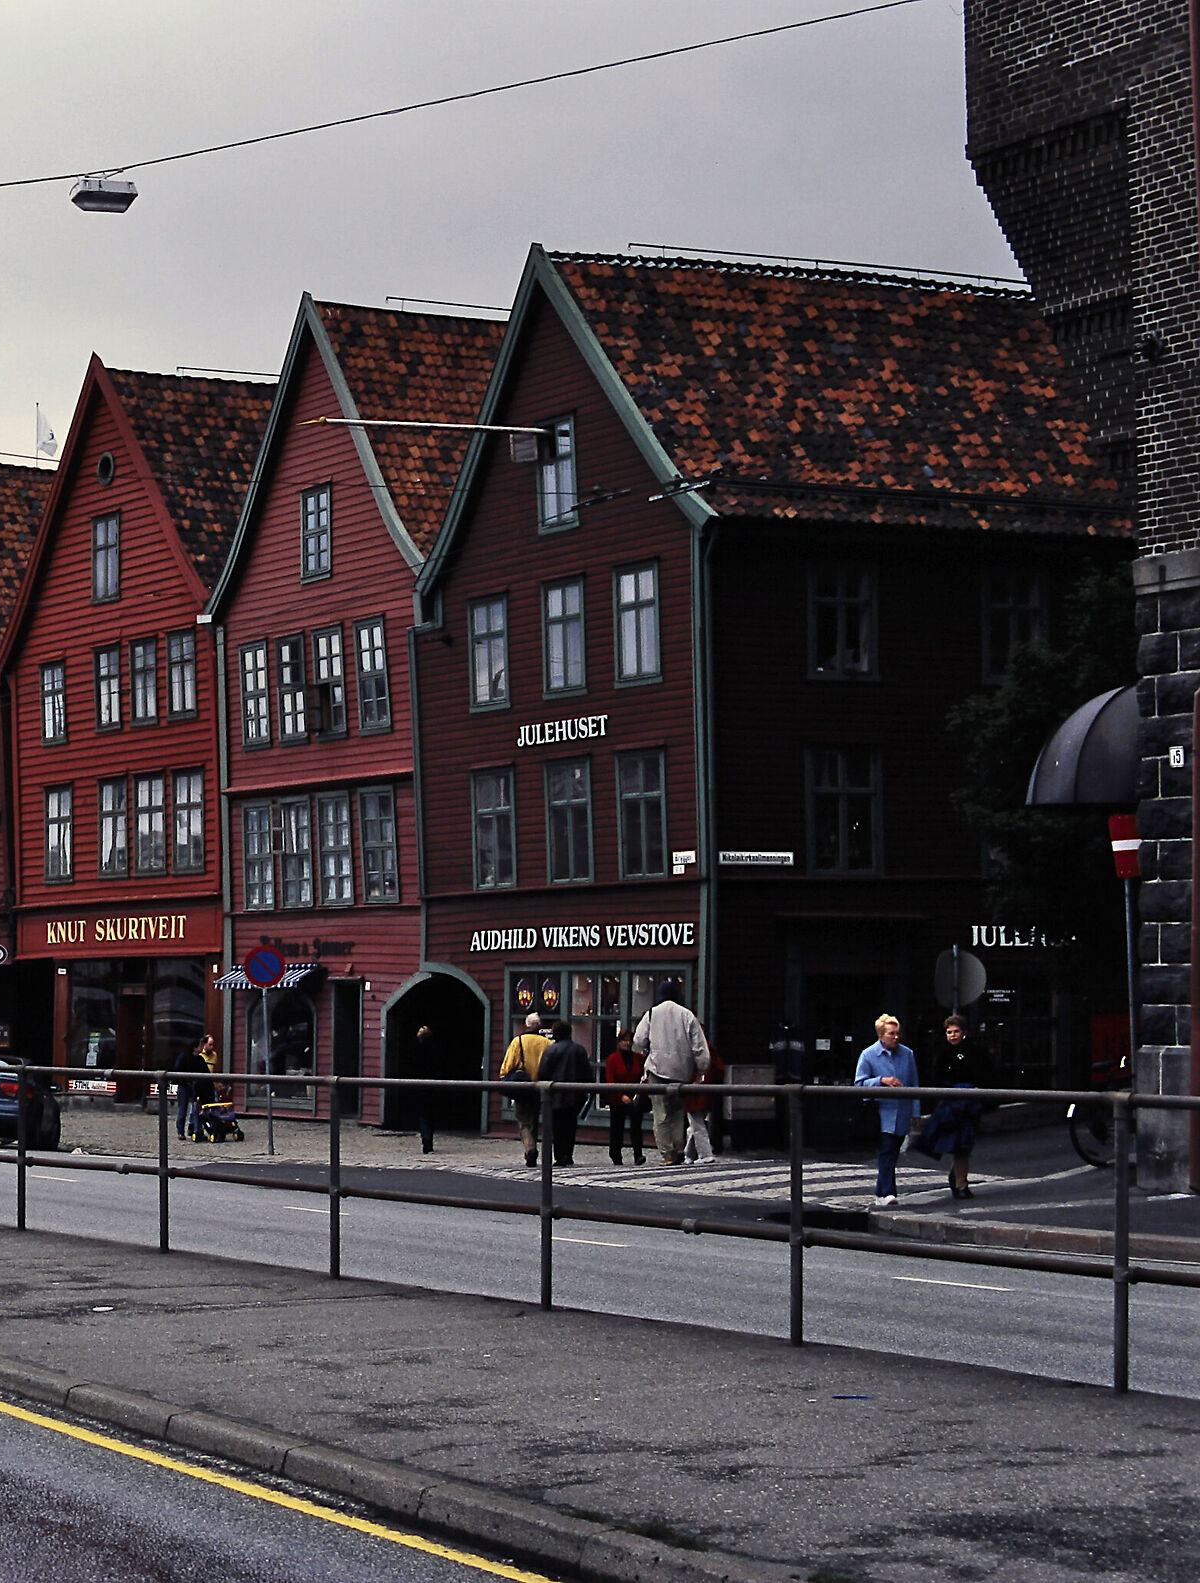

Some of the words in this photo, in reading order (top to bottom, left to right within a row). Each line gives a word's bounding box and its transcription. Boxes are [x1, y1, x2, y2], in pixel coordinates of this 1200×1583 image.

[517, 714, 608, 747] JULEHUSET
[47, 920, 87, 944] KNUT
[95, 915, 187, 942] SKURTVEIT
[470, 928, 537, 951] AUDHILD
[542, 925, 600, 947] VIKENS
[605, 923, 694, 947] VEVSTOVE
